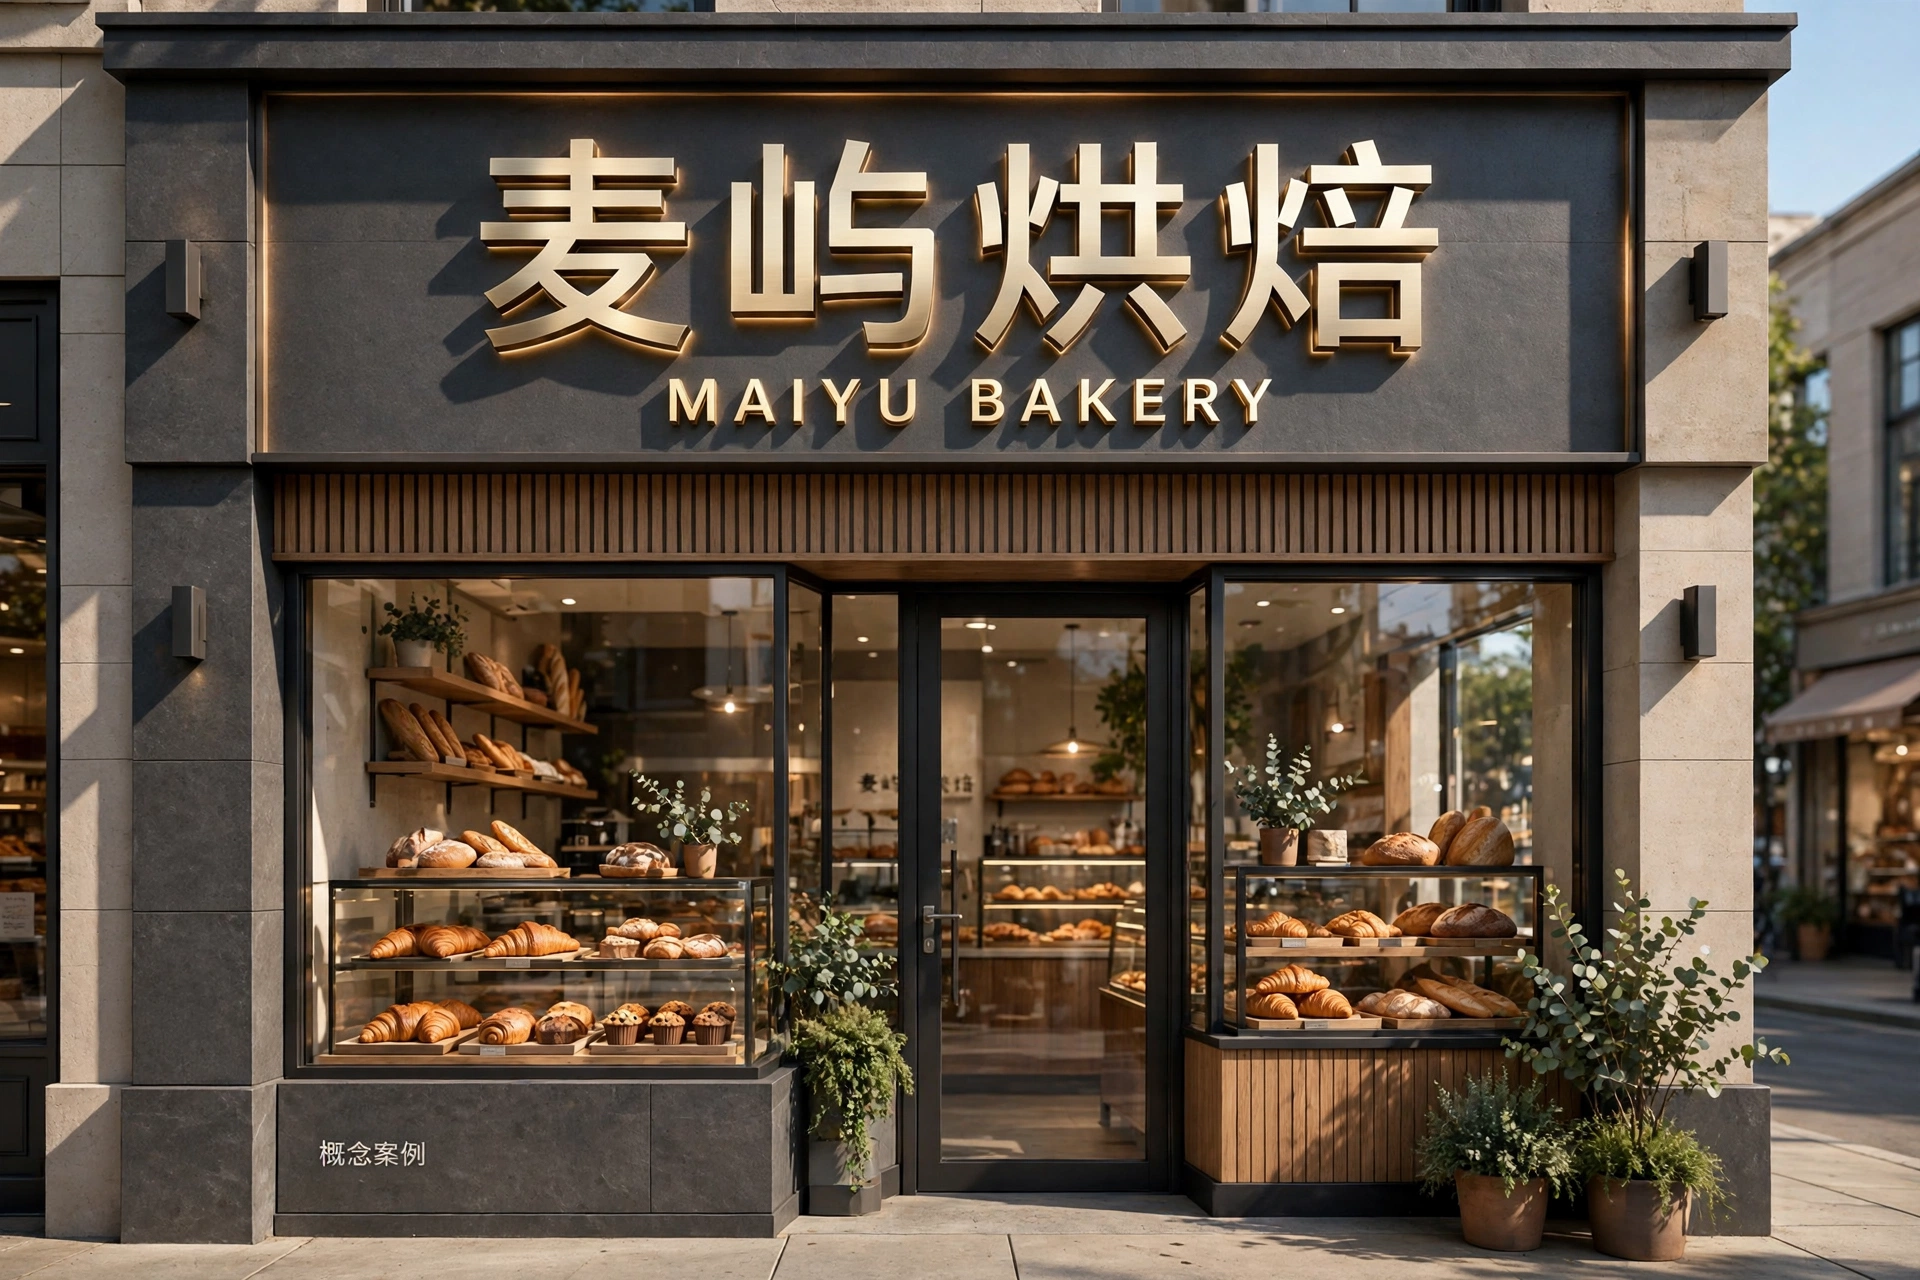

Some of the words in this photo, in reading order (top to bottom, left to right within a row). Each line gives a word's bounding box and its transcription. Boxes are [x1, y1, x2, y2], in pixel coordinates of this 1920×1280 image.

[479, 137, 1439, 357] 麦屿烘焙
[668, 378, 917, 427] MAIYU
[970, 378, 1273, 426] BAKERY
